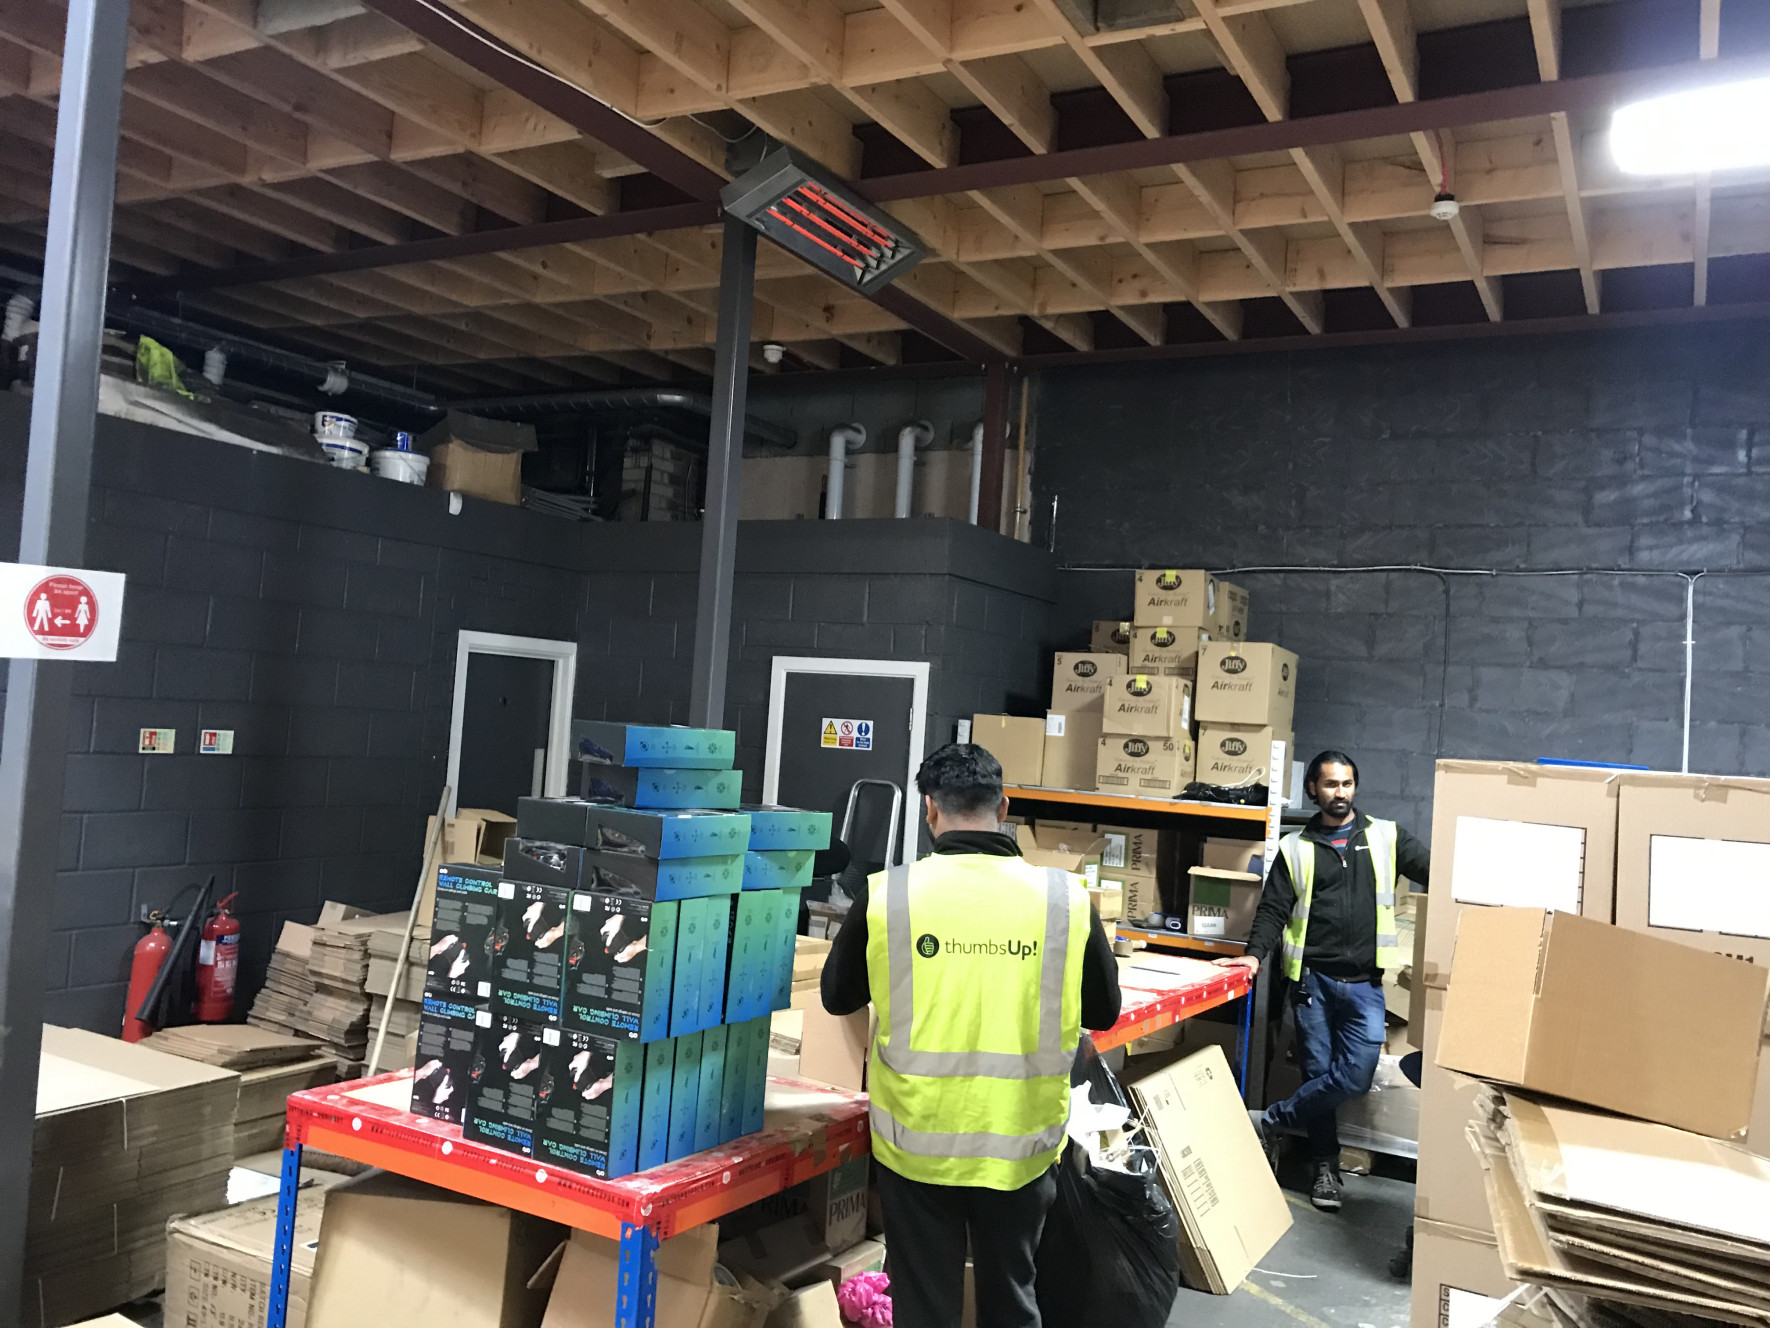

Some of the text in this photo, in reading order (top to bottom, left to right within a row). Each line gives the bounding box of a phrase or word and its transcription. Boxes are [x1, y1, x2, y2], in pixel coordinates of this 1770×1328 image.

[1147, 596, 1189, 607] Airkraft
[1142, 653, 1181, 664] Airkraft
[1221, 658, 1246, 672] Jiffy
[1074, 663, 1096, 675] Jiffy
[1211, 681, 1254, 692] Airkraft
[1117, 703, 1160, 715] Airkraft
[1124, 741, 1148, 755] Jiffy
[1163, 742, 1174, 751] 50
[1221, 740, 1247, 754] Jiffy
[1114, 763, 1156, 776] Airkraft
[1131, 833, 1143, 871] PRIMA
[438, 874, 493, 888] REMOTE CONTROL
[438, 880, 454, 888] WALL
[1127, 881, 1139, 921] PRIMA
[1191, 904, 1229, 920] PRIMA
[945, 938, 1038, 960] thumbsUp!
[573, 1004, 588, 1014] CAR
[579, 1013, 639, 1032] REMOTE CONTROL
[622, 1015, 639, 1024] WALL
[543, 1139, 557, 1149] CAR
[549, 1147, 578, 1161] CONTROL
[829, 1191, 867, 1227] PRIMA
